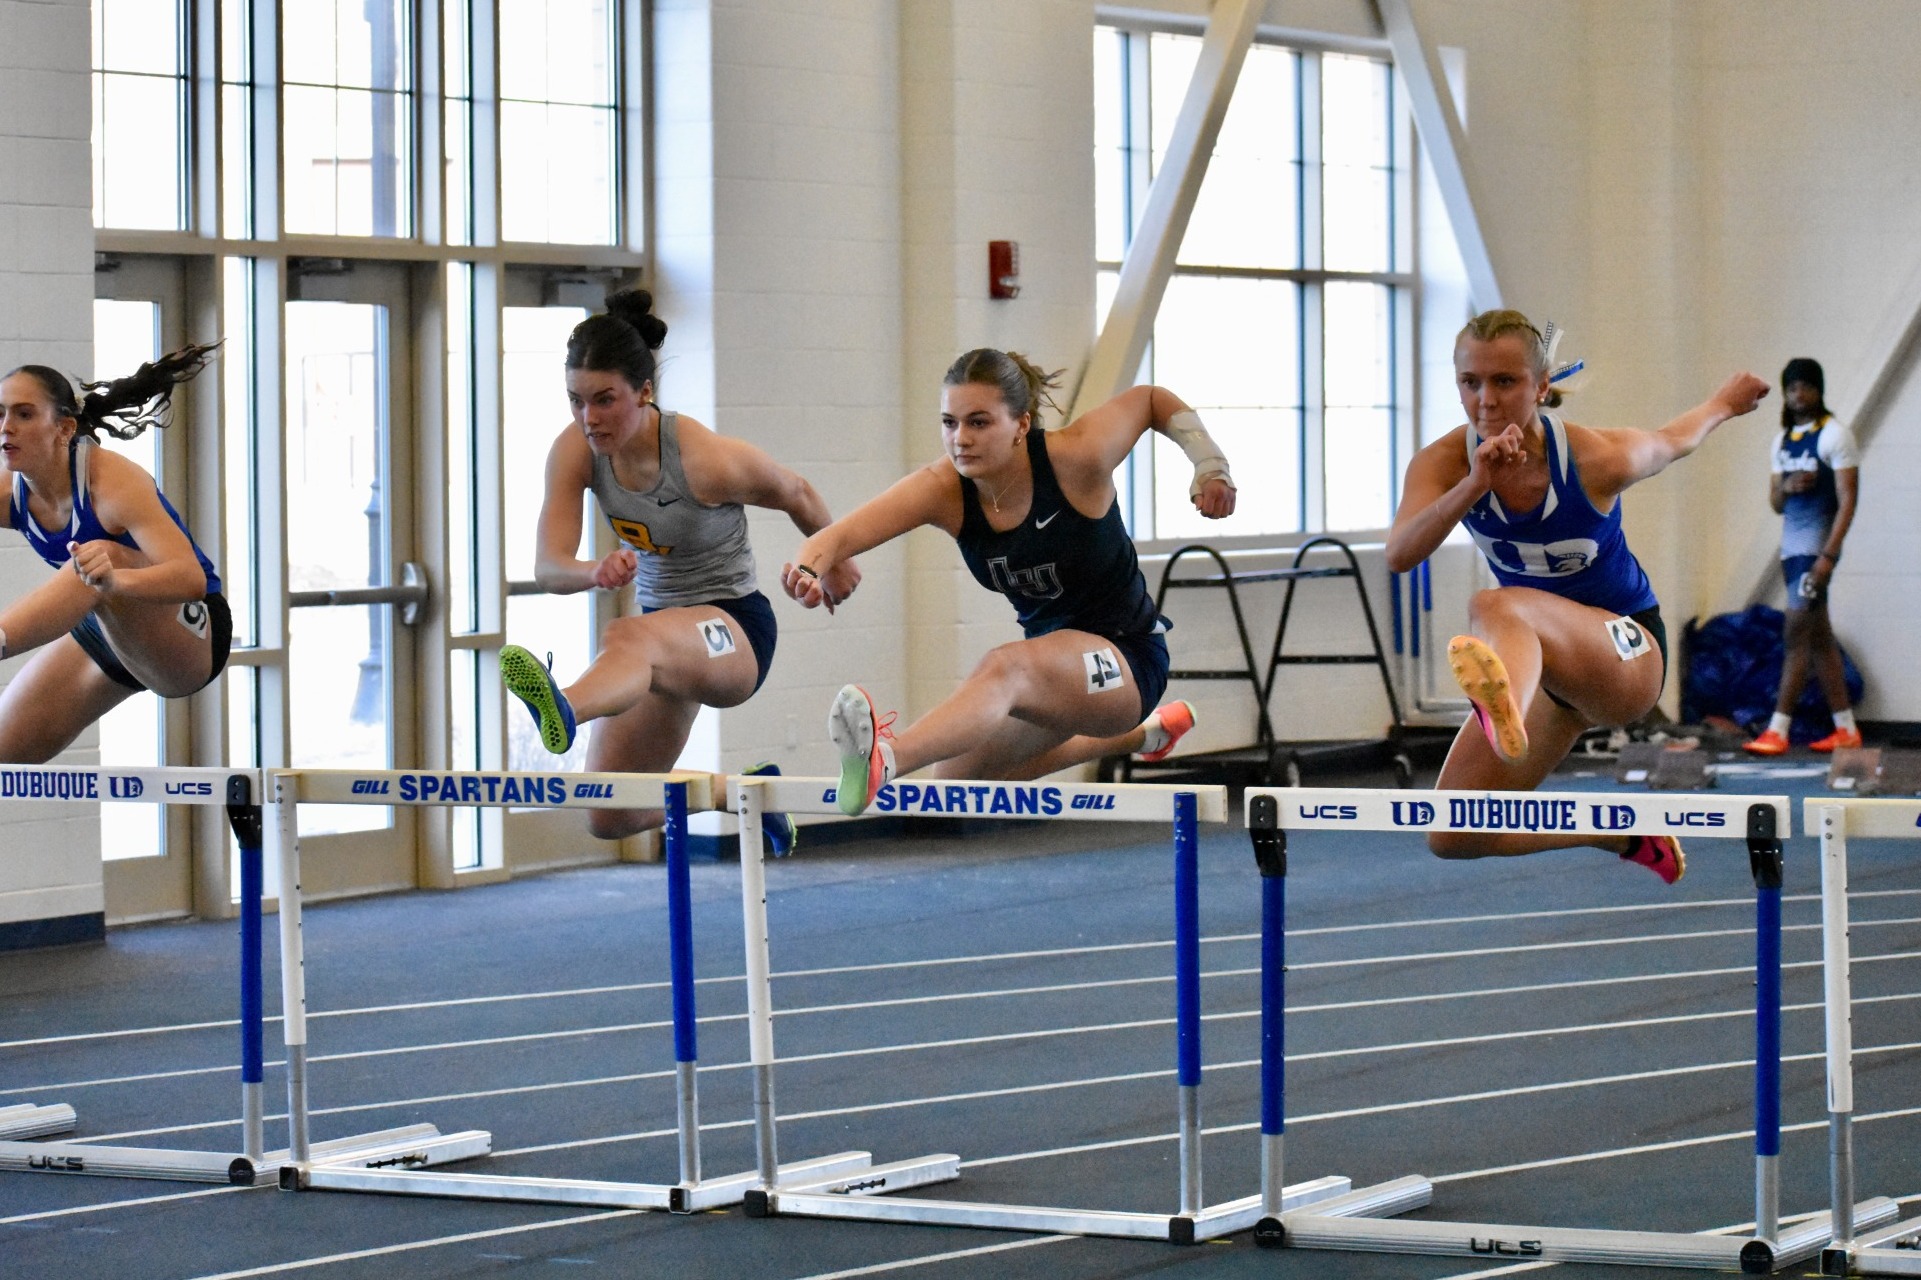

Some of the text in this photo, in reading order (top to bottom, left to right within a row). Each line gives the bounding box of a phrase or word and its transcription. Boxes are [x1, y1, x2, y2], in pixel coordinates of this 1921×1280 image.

[986, 556, 1064, 599] LU
[704, 623, 733, 652] 5
[1612, 621, 1643, 654] 3
[1091, 653, 1121, 688] 4
[1, 770, 98, 800] DUBUQUE
[165, 782, 212, 796] UCS
[351, 775, 613, 804] GILL SPARTANS GILL
[877, 784, 1115, 815] SPARTANS GILL
[1299, 805, 1358, 820] UCS
[1449, 798, 1577, 831] DUBUQUE
[1665, 812, 1726, 827] UCS
[28, 1154, 84, 1171] UCS
[1470, 1237, 1543, 1256] UCS
